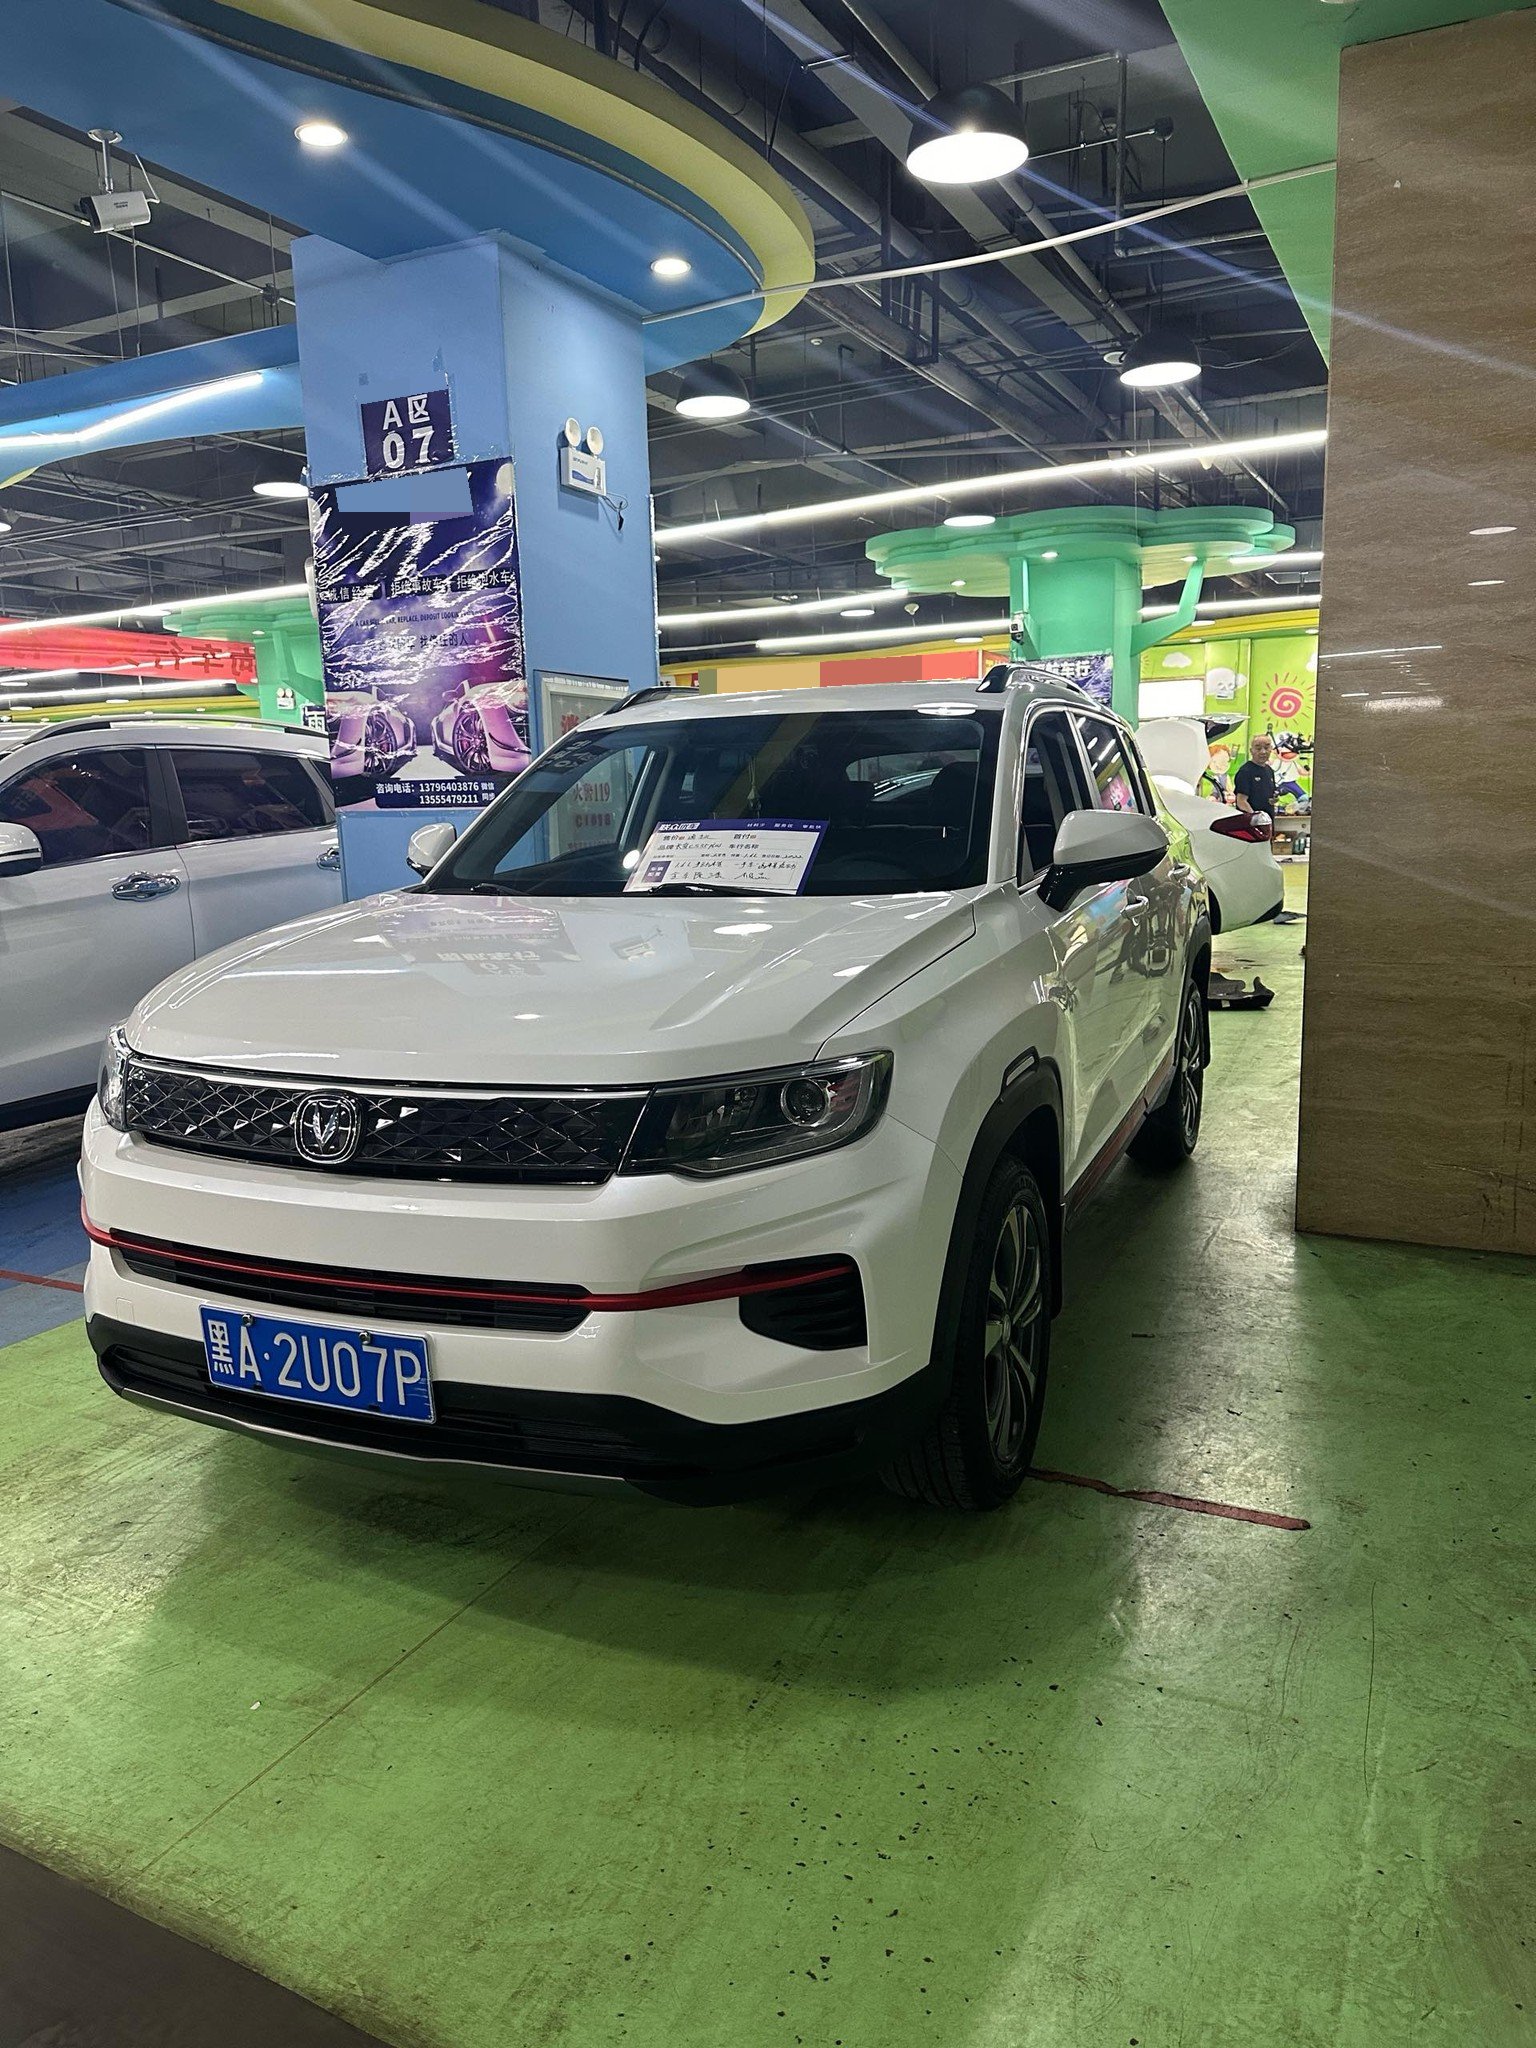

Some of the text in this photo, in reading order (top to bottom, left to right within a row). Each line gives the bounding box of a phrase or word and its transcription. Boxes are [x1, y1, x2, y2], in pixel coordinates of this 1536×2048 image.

[382, 426, 435, 469] 07
[419, 781, 479, 793] 13796403876
[419, 794, 479, 805] 13555479211
[207, 1319, 422, 1406] 黑A·2U07P
